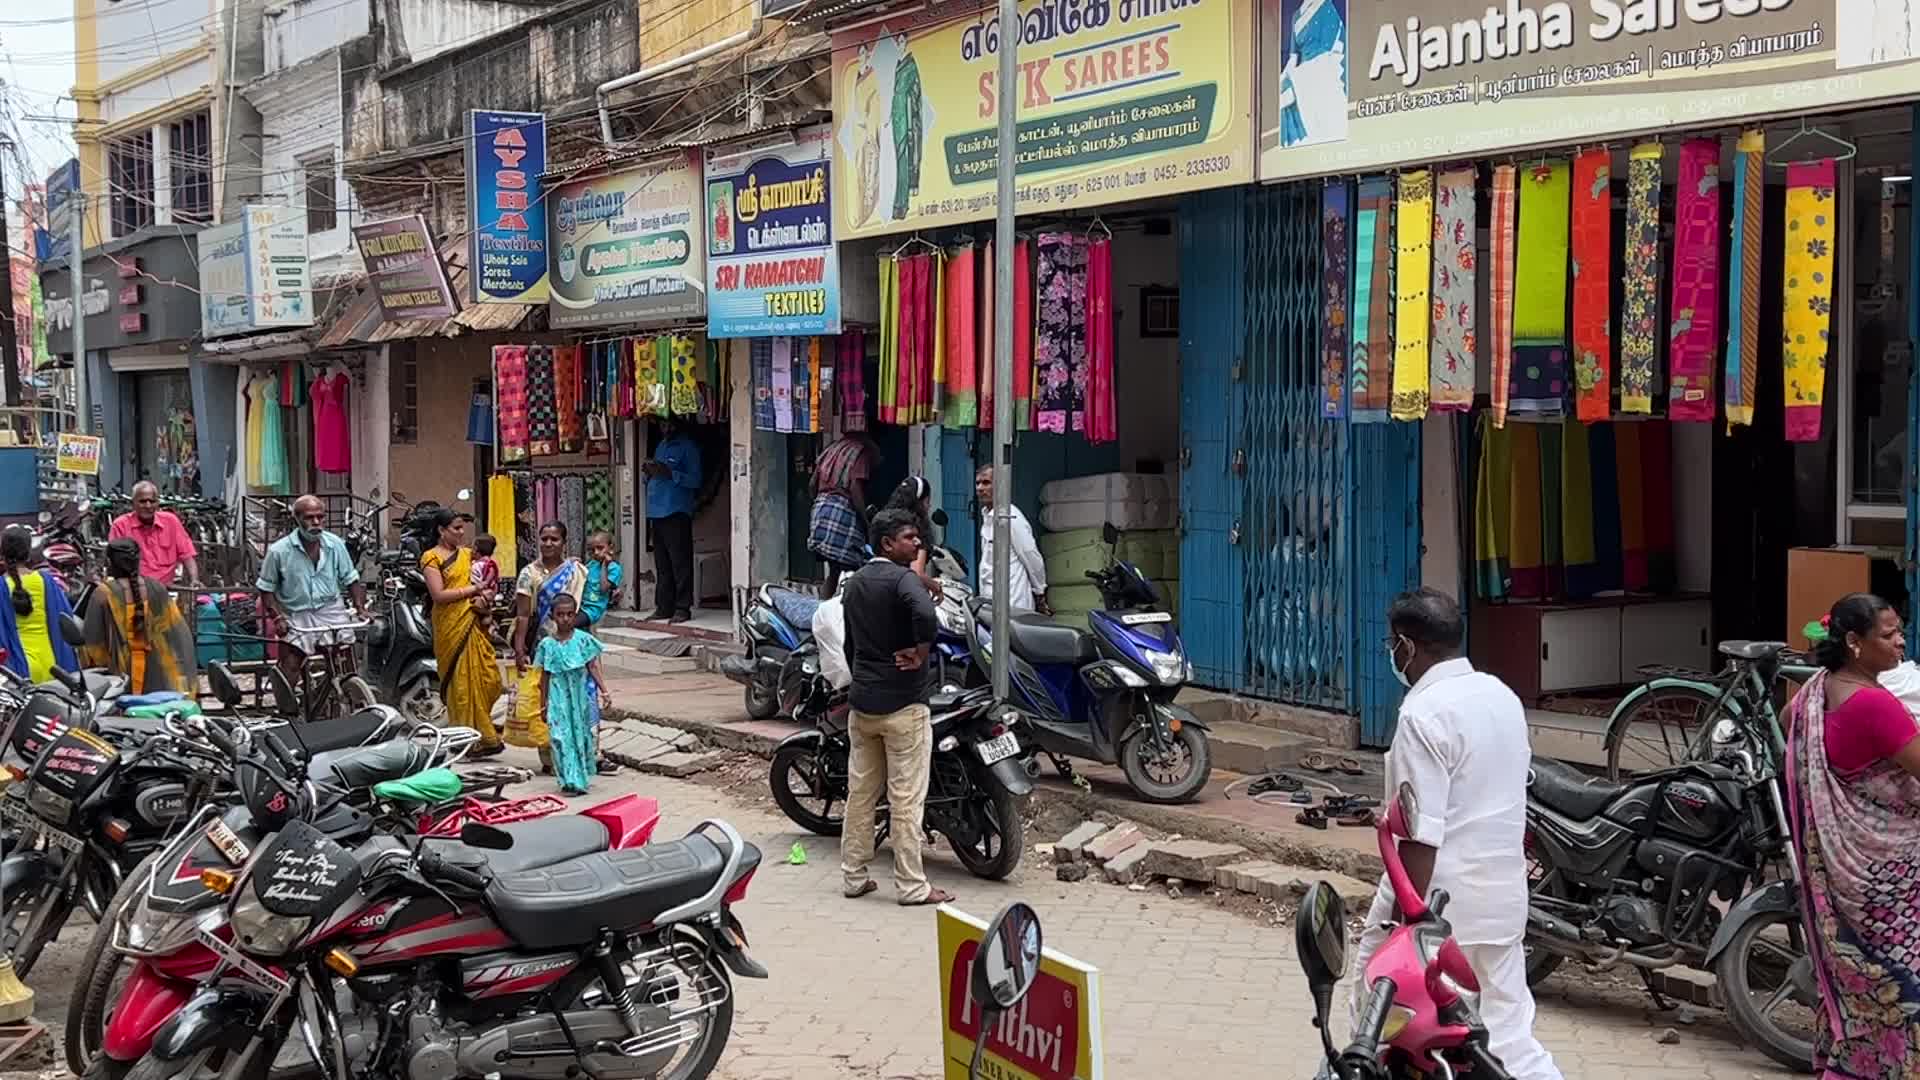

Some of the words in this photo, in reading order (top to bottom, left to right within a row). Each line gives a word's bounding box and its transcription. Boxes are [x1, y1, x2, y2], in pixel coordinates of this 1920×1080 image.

[1369, 0, 1574, 86] Ajantha
[1590, 0, 1790, 40] Sar
[979, 57, 1051, 118] SK
[1064, 35, 1169, 91] SAREES
[1401, 81, 1469, 111] சேலைகள்
[1562, 53, 1642, 85] சேலைகள்
[1660, 40, 1725, 70] மொத்த
[1730, 21, 1824, 59] வியாபாரம்
[1131, 95, 1196, 123] சேலைகள்
[1081, 132, 1127, 152] மொத்த
[1131, 116, 1200, 144] வியாபாரம்
[493, 127, 529, 231] AYSHA
[760, 168, 826, 211] காமாட்சி
[1087, 177, 1102, 193] 625
[1154, 163, 1177, 181] 0452
[1186, 154, 1231, 177] 2335330
[480, 233, 544, 252] Textiles
[483, 253, 509, 266] Whole
[483, 278, 526, 290] Merchants
[715, 264, 740, 291] SRI
[744, 255, 826, 290] KAMATCHI
[764, 288, 826, 317] TEXTILES
[960, 959, 1063, 1073] ithvi
